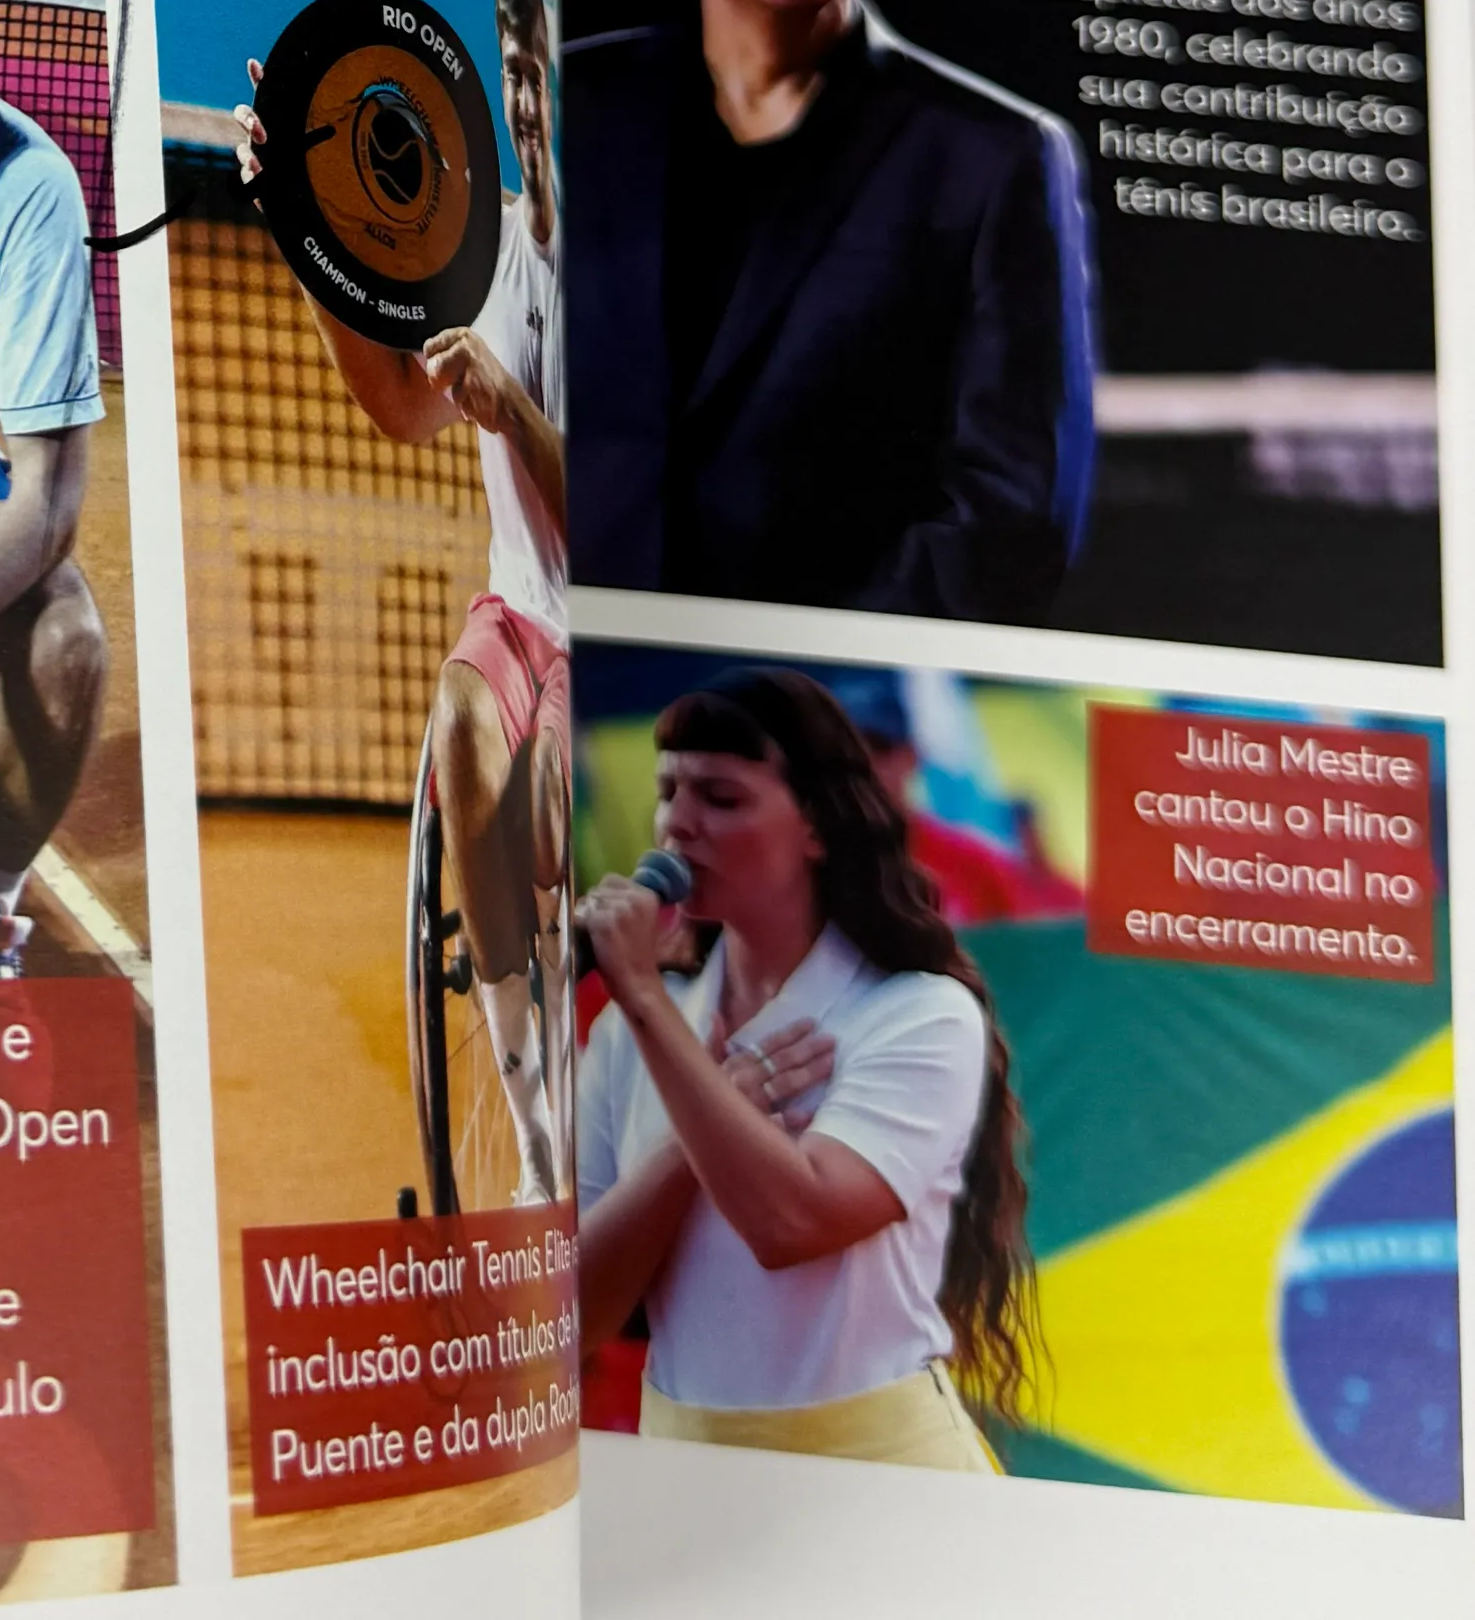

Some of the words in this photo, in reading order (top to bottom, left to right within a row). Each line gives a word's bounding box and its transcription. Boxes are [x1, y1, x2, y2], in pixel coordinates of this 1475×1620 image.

[382, 5, 416, 34] RIO
[420, 23, 463, 81] OPEN
[1073, 15, 1184, 65] 1980,
[1186, 28, 1422, 83] celebrando
[1079, 76, 1161, 109] sua
[1161, 83, 1423, 137] contribuição
[1100, 119, 1282, 175] histórica
[1283, 147, 1386, 184] para
[1386, 158, 1424, 188] o
[1116, 177, 1224, 222] tênis
[1223, 184, 1423, 242] brasileiro.
[304, 236, 366, 305] CHAMPION
[377, 299, 426, 320] SINGLES
[1175, 726, 1275, 776] Julia
[1280, 735, 1421, 790] Mestre
[1134, 790, 1276, 830] cantou
[1285, 804, 1320, 839] o
[1323, 798, 1421, 848] Hino
[1173, 843, 1360, 901] Nacional
[1365, 870, 1421, 907] no
[1125, 908, 1420, 965] encerramento.
[2, 1025, 33, 1060] e
[261, 1245, 466, 1311] Wheelchair
[472, 1236, 541, 1287] Tennis
[545, 1227, 571, 1274] Elite
[266, 1334, 420, 1396] inclusão
[430, 1331, 492, 1375] com
[498, 1310, 554, 1366] títulos
[558, 1302, 571, 1347] de
[271, 1422, 405, 1483] Puente
[413, 1426, 433, 1460] e
[442, 1404, 479, 1456] da
[487, 1389, 546, 1453] dupla
